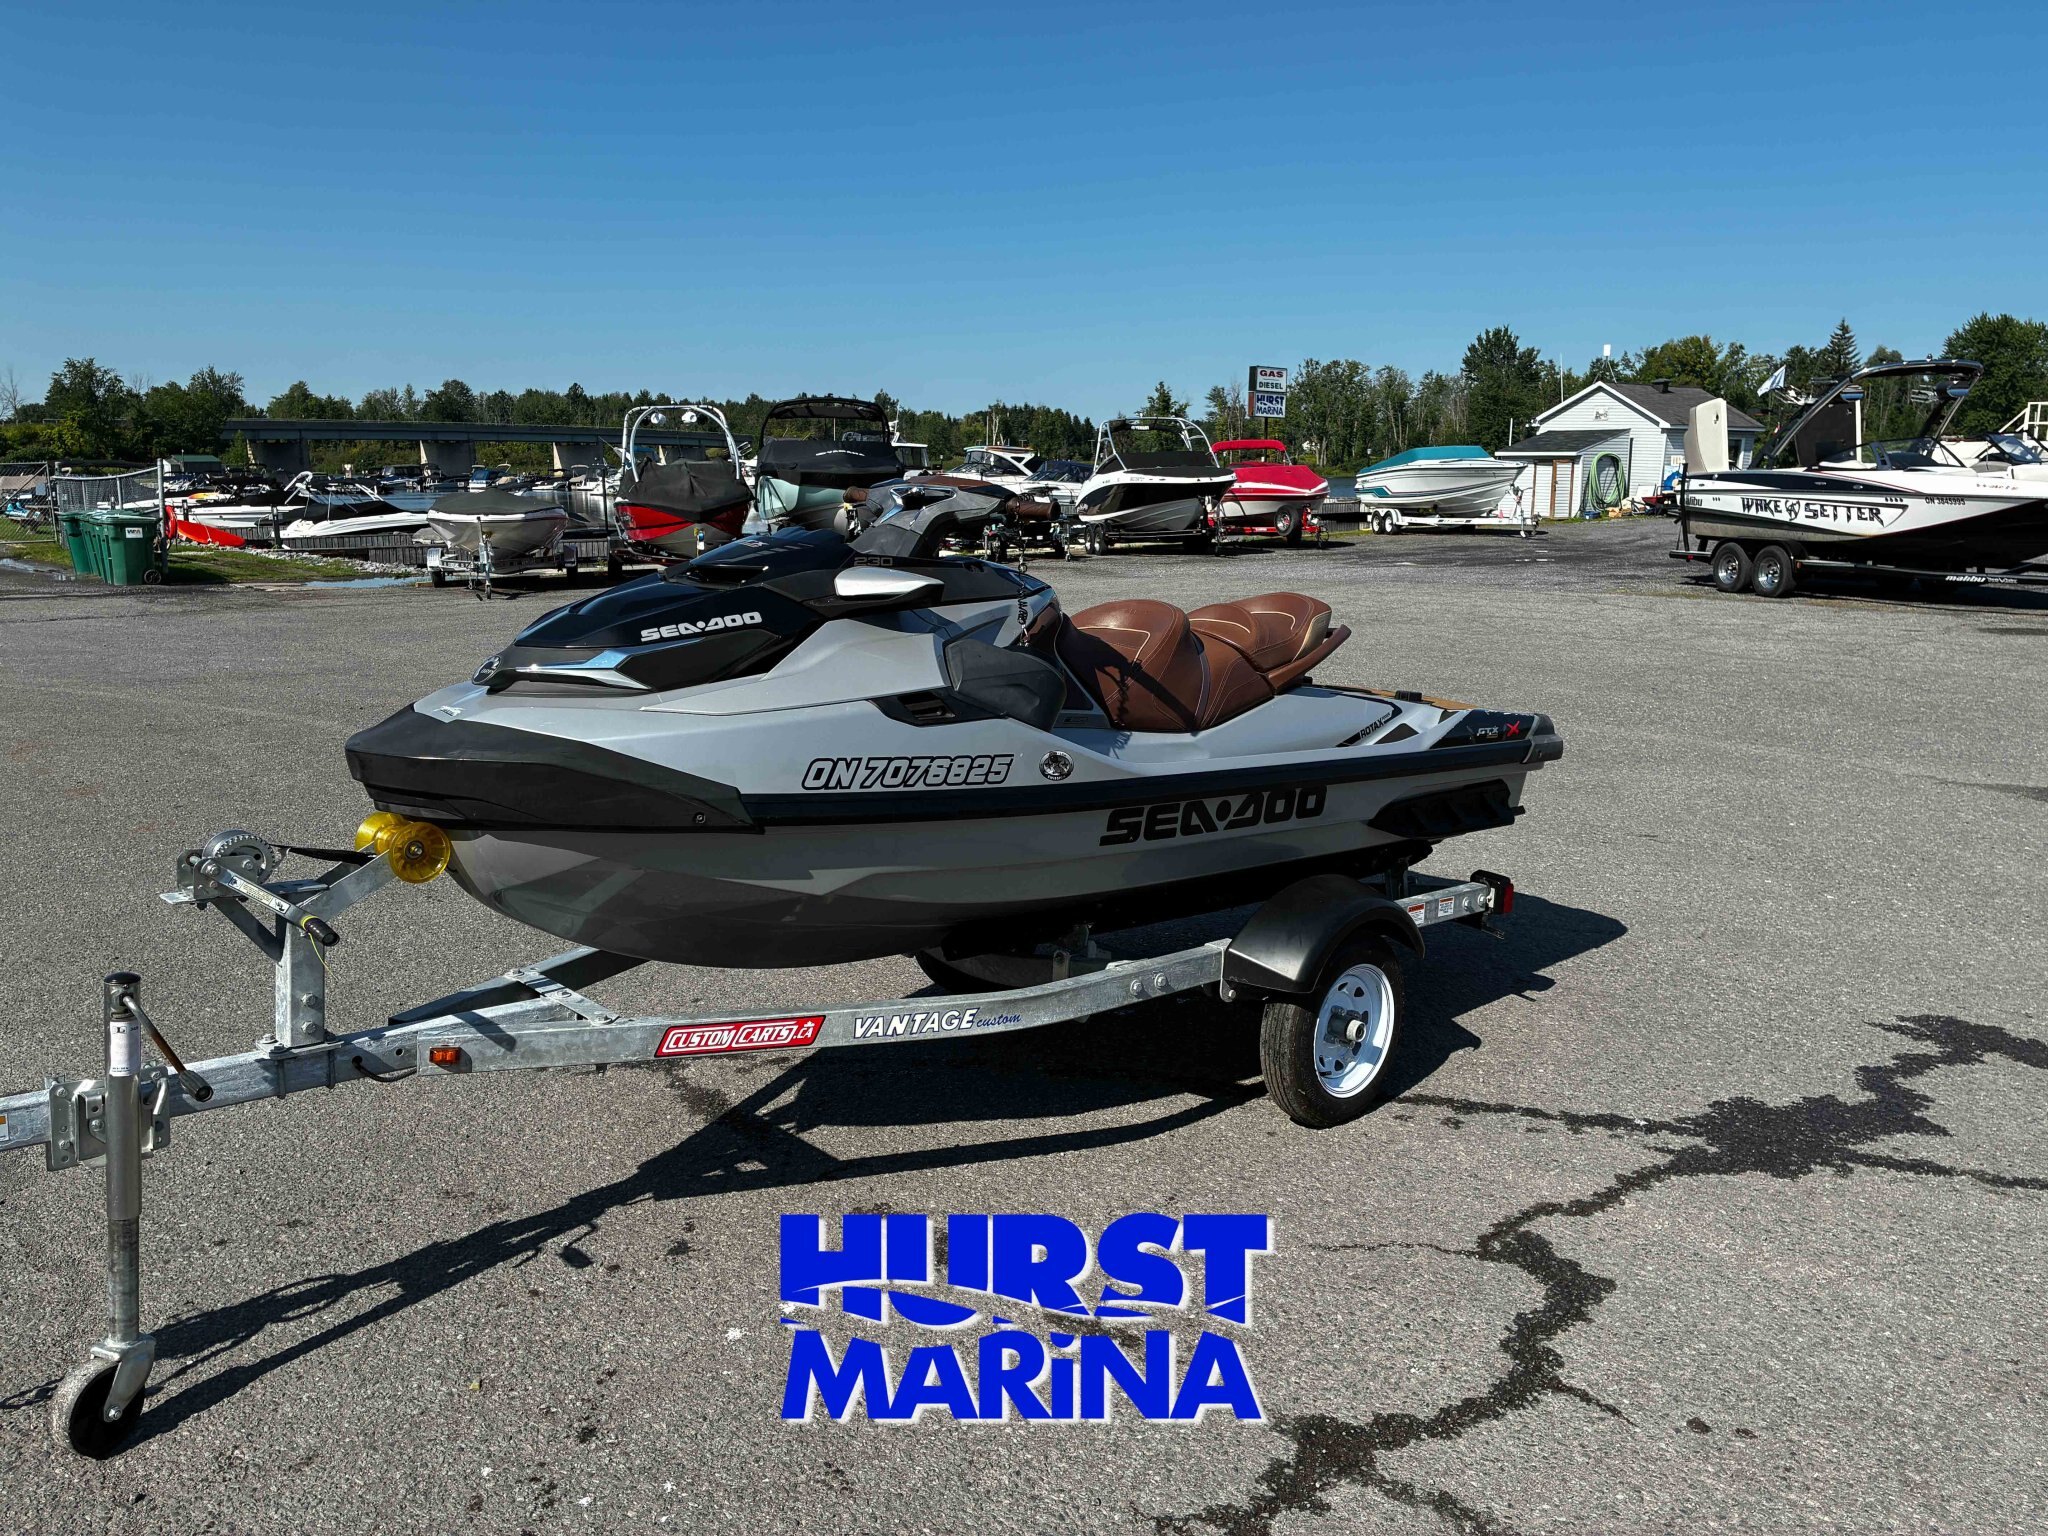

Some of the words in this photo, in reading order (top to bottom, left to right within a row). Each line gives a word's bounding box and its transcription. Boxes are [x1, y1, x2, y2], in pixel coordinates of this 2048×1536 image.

[1260, 370, 1284, 378] GAS
[1256, 394, 1284, 406] HURST
[1684, 495, 1703, 507] alibu
[1925, 496, 1935, 505] ON
[1740, 497, 1782, 517] WAKE
[1804, 502, 1885, 527] SETTER
[854, 556, 893, 567] 230
[1360, 717, 1385, 739] ROTAX
[802, 757, 861, 790] ON
[860, 753, 1014, 790] 7076825
[853, 1006, 981, 1039] VANTAGE
[976, 1013, 1022, 1028] custom
[668, 1029, 737, 1049] CUSTOM
